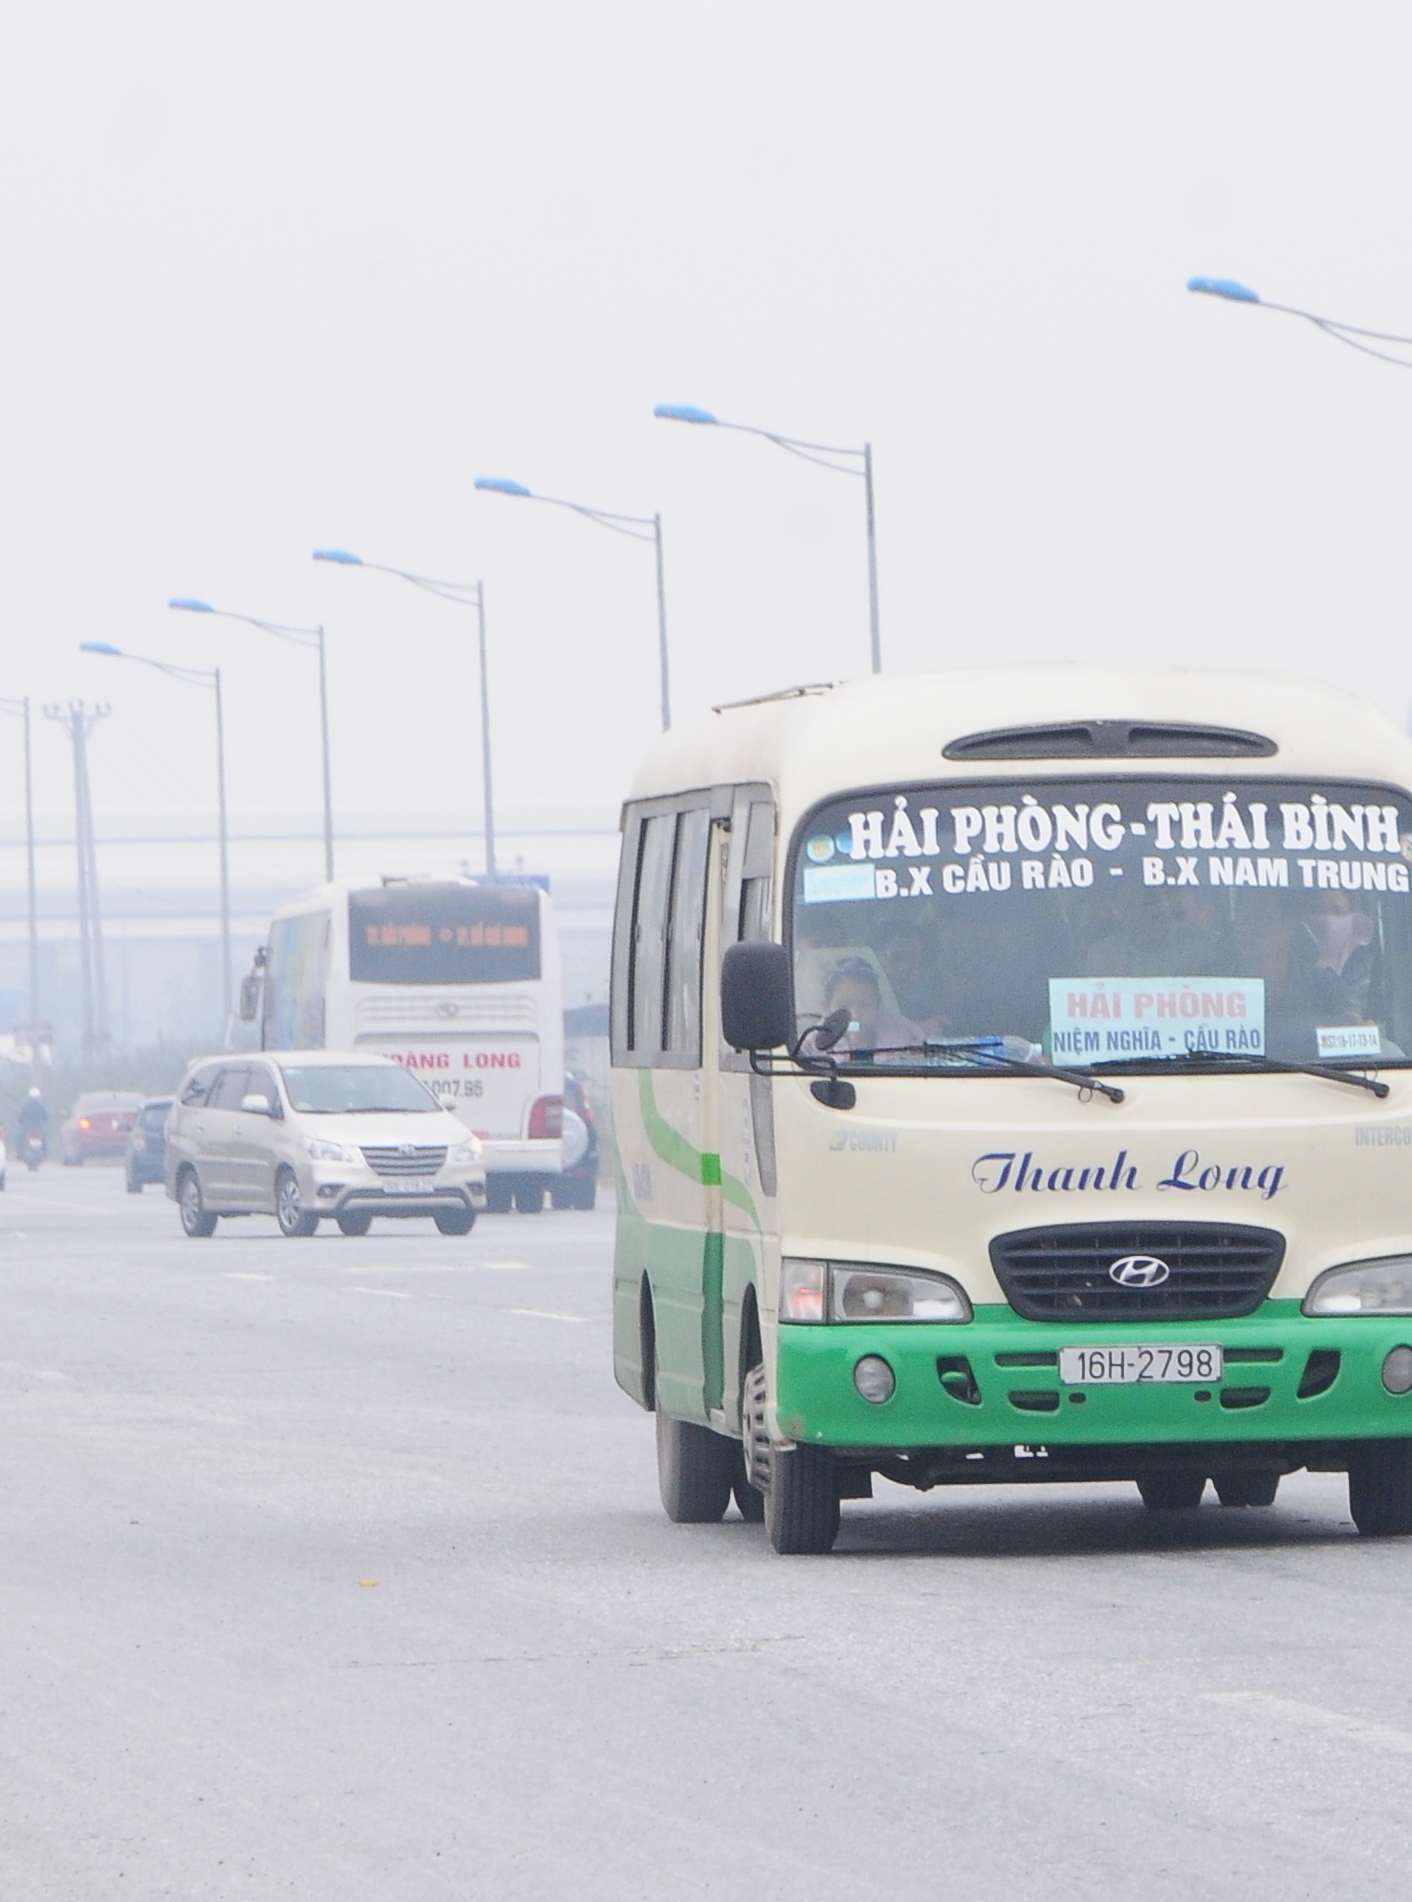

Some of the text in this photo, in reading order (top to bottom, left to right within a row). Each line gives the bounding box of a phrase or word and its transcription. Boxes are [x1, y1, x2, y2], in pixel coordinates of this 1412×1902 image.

[848, 795, 941, 860] HẢI
[1279, 794, 1402, 853] BÌNH
[875, 866, 933, 899] B.X
[942, 851, 1011, 894] CẦU
[1021, 849, 1094, 889] RÀO
[1143, 856, 1200, 886] B.X
[1208, 857, 1289, 887] NAM
[1297, 857, 1410, 893] TRUNG
[1067, 982, 1247, 1018] HẢI PHÒNG
[1053, 1027, 1100, 1056] NIỆM
[1107, 1026, 1162, 1050] NGHĨA
[1226, 1024, 1261, 1049] RÀO
[384, 1049, 521, 1069] OÀNG LONG
[423, 1079, 483, 1098] 007.95
[972, 1149, 1287, 1200] Thanh Long
[1078, 1349, 1213, 1380] 16H-2798
